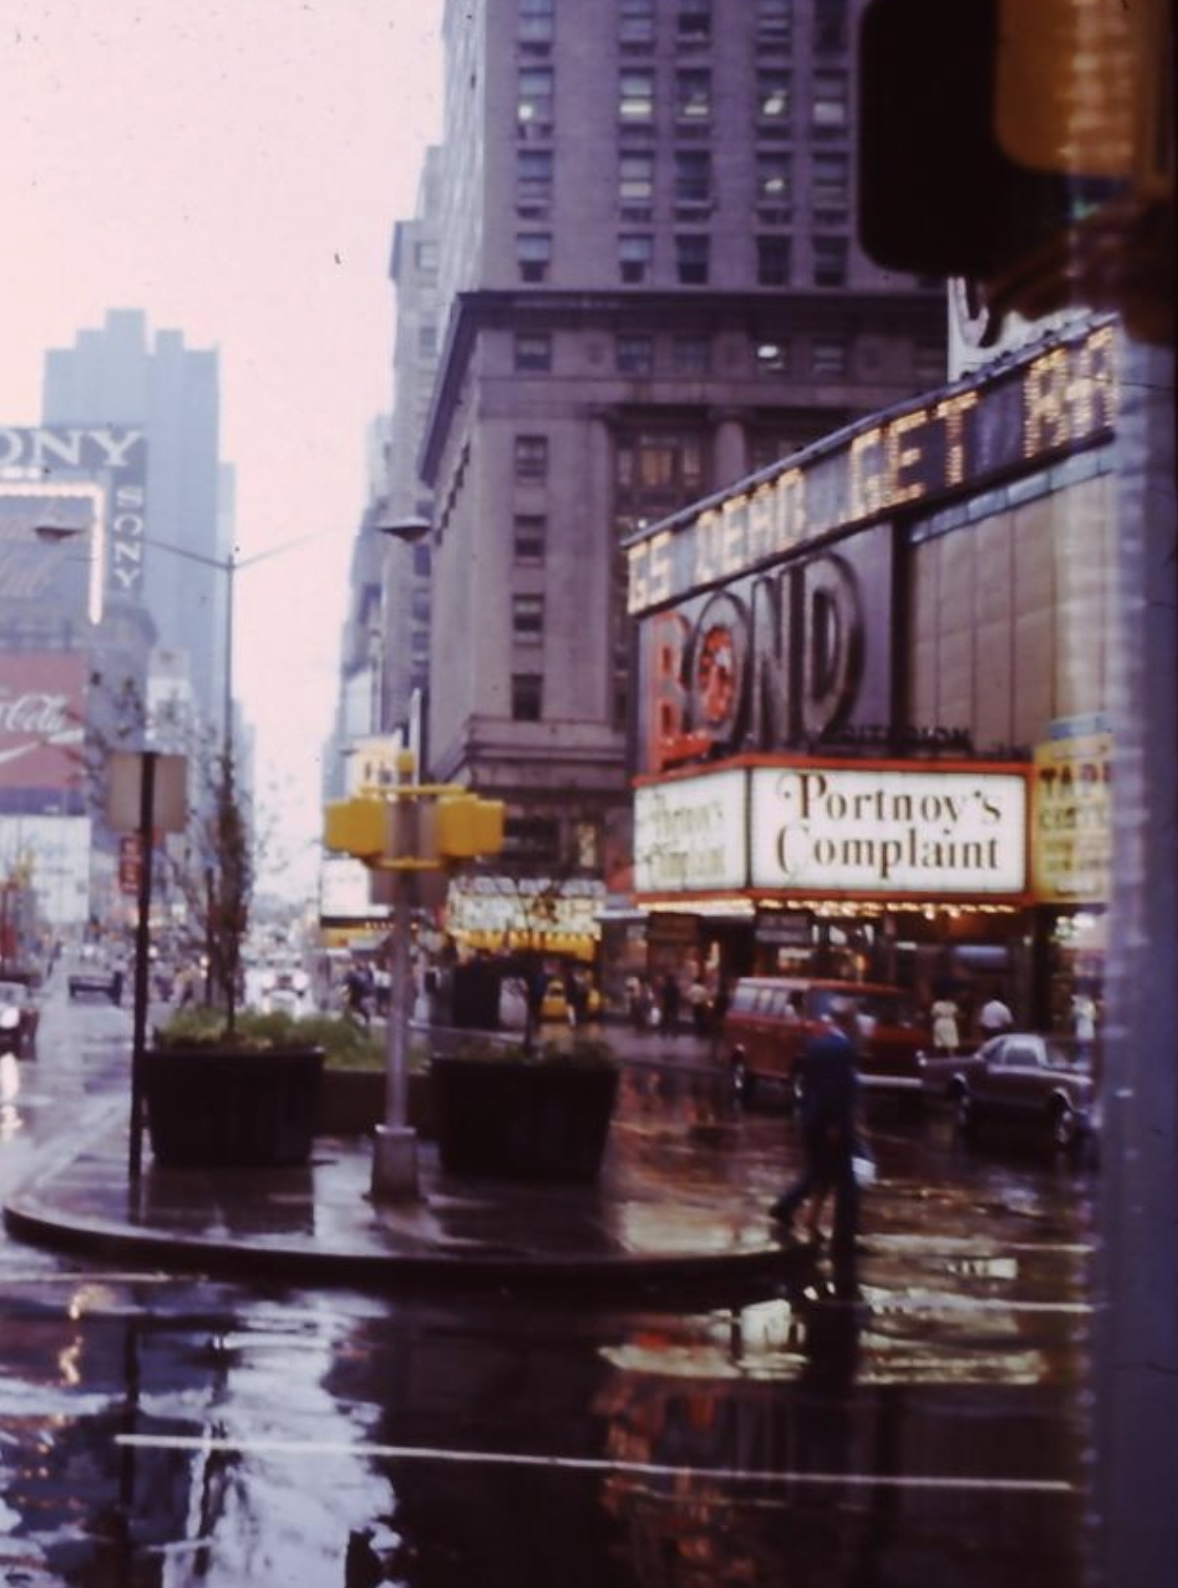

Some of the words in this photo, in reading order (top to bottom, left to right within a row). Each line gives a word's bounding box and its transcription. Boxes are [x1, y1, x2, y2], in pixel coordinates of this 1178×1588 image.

[849, 391, 978, 523] GET
[113, 486, 144, 589] SONY
[647, 551, 865, 769] BOND
[778, 772, 1003, 825] Portnoy's
[776, 826, 1000, 880] Complaint
